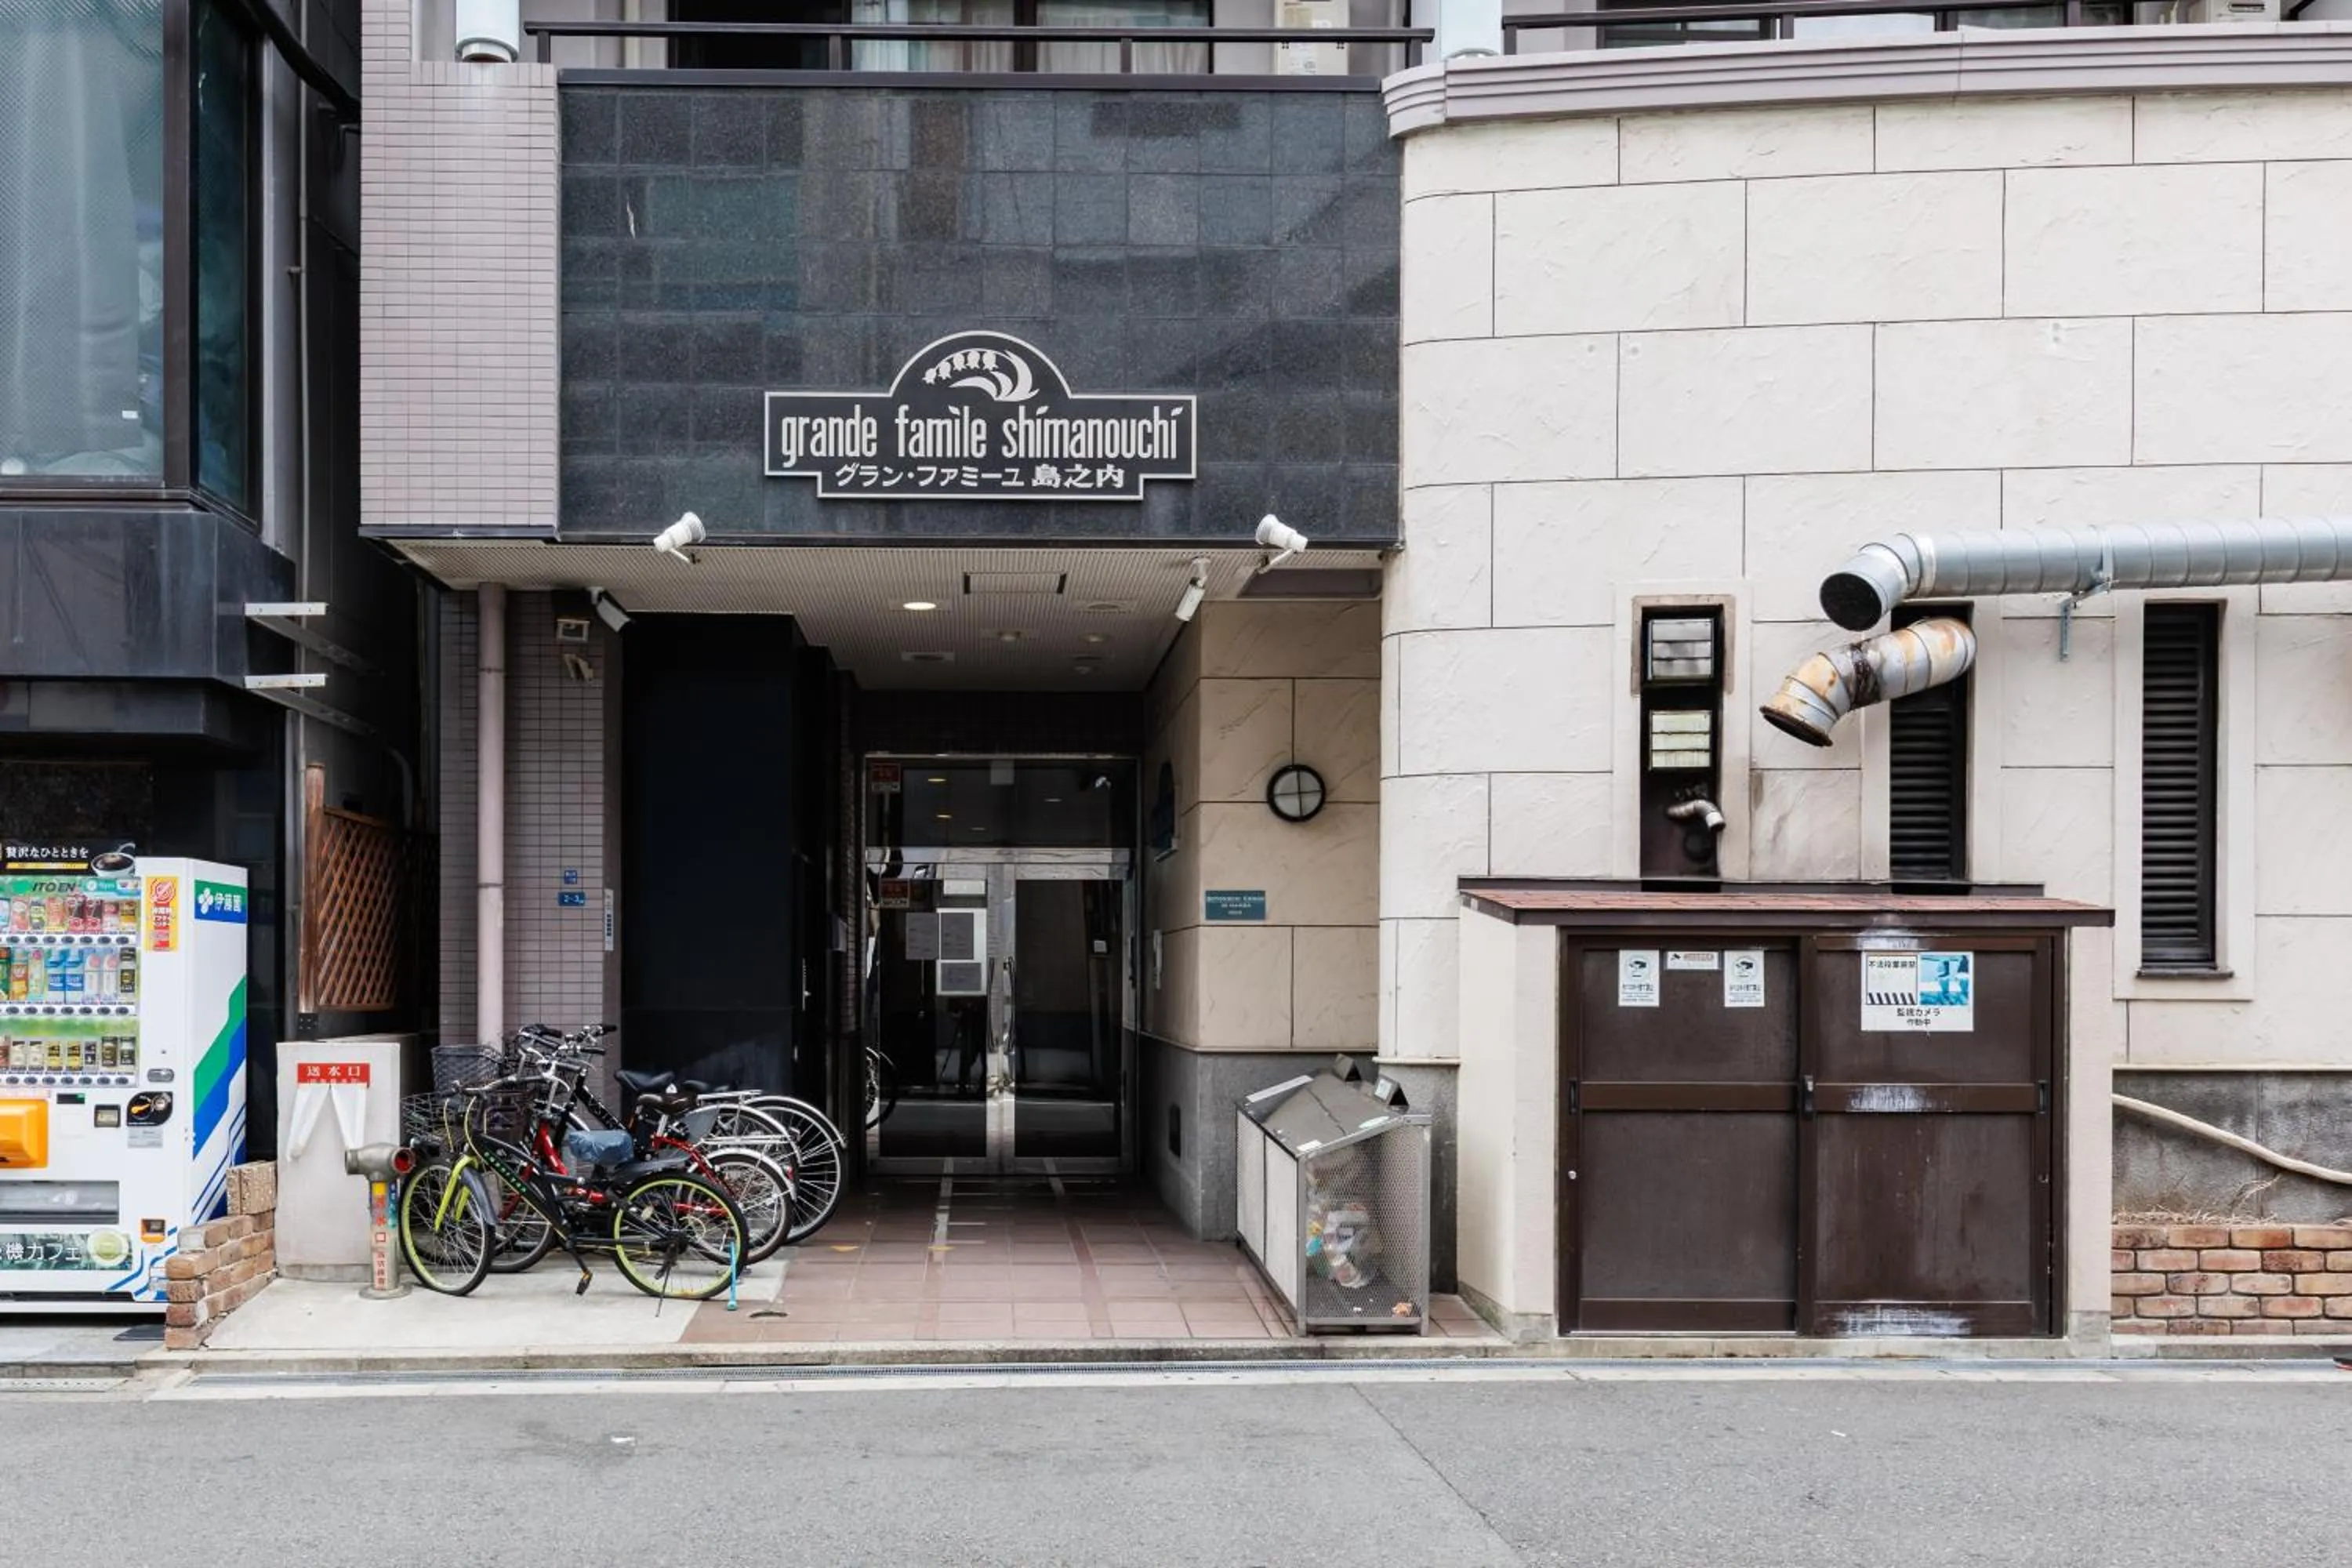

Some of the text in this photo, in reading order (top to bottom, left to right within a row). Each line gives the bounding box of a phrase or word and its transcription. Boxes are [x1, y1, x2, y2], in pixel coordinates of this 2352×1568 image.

[782, 405, 1184, 468] grande famile shimanouchi
[5, 846, 89, 858] 贅沢なひとときを
[33, 882, 77, 892] ITO EN
[215, 892, 242, 913] 伊藤園
[307, 1065, 360, 1077] 送水口
[0, 1242, 81, 1261] 機カフェ
